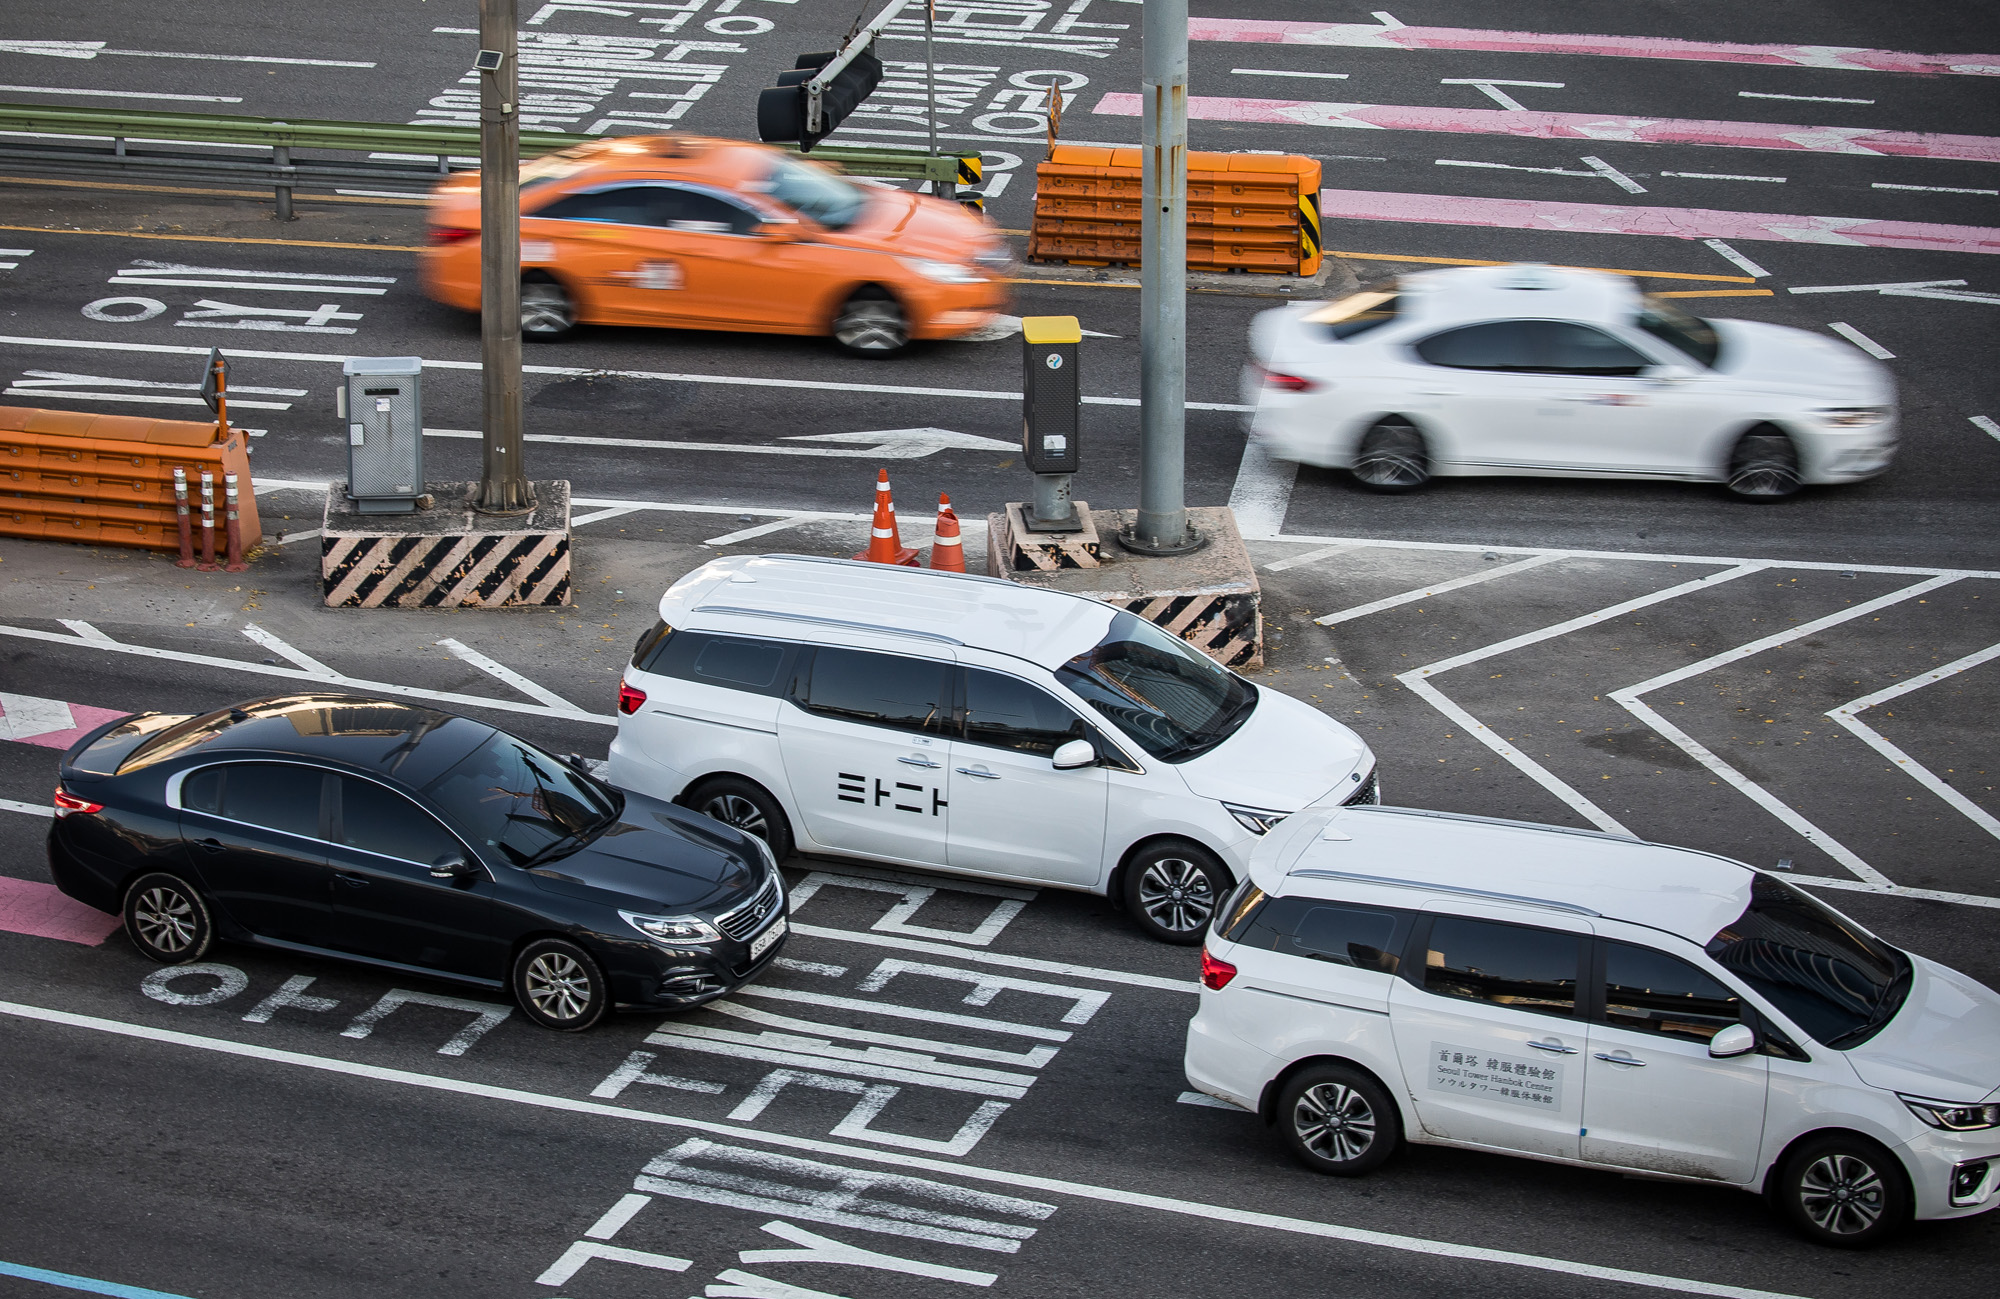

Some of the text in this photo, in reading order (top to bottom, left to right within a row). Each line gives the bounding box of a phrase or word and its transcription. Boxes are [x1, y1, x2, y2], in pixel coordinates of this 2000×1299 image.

[80, 258, 399, 336] 시청
[837, 771, 949, 817] 타다
[1437, 1064, 1554, 1093] Seoul Tower Hanbok Center
